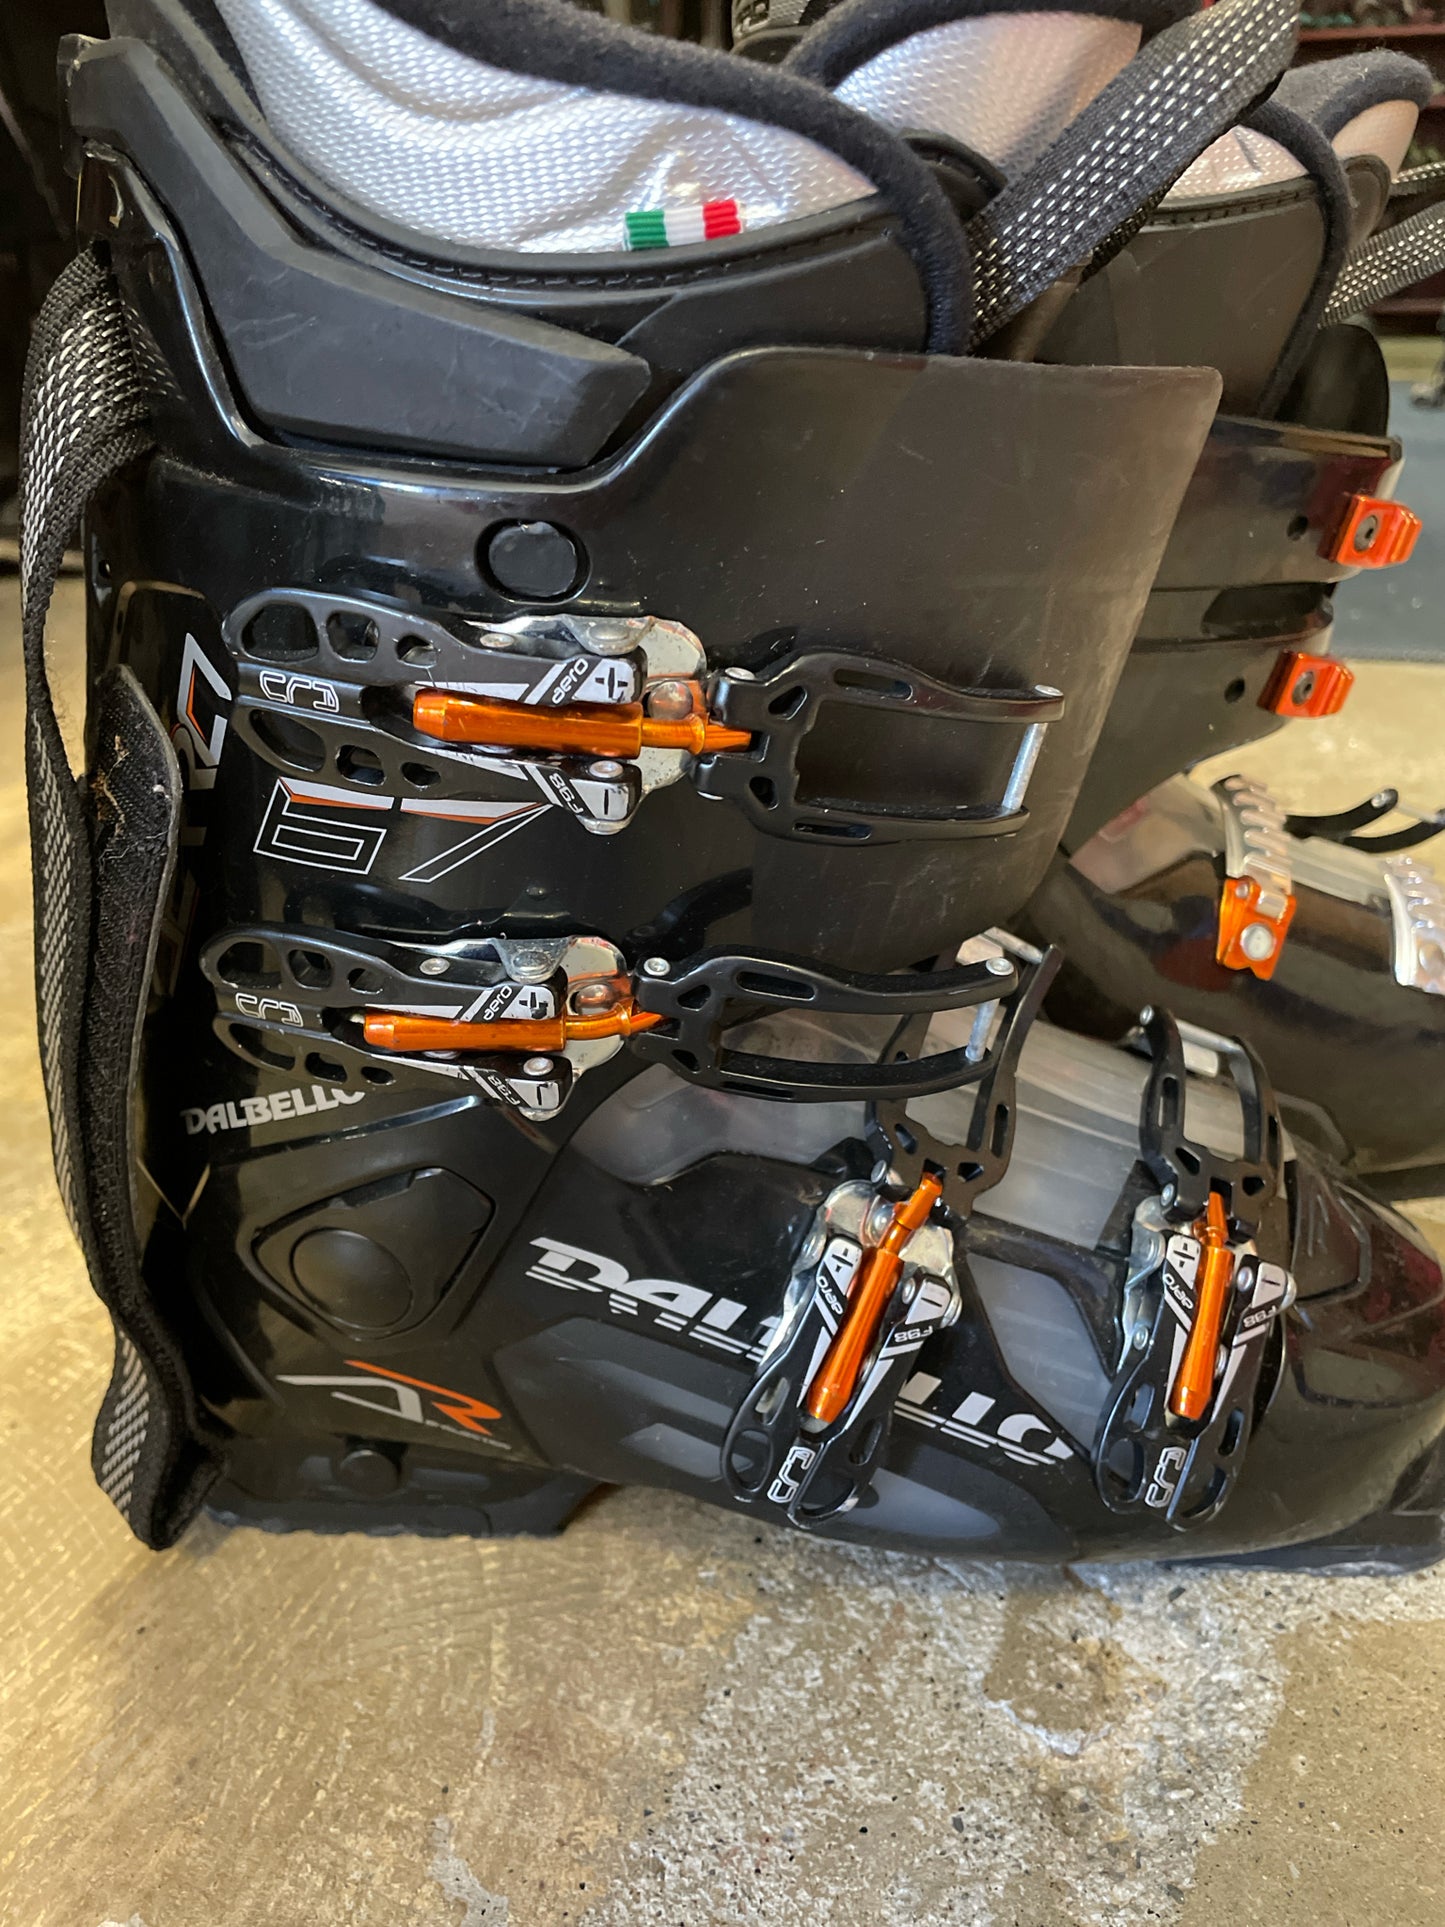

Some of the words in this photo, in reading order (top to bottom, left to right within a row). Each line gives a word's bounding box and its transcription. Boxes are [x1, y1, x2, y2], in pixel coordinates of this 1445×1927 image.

[551, 657, 589, 705] aero
[549, 773, 584, 815] F98
[484, 985, 513, 1020] aero
[815, 1275, 843, 1316] aero
[1164, 1273, 1193, 1309] aero
[894, 1323, 933, 1344] F98
